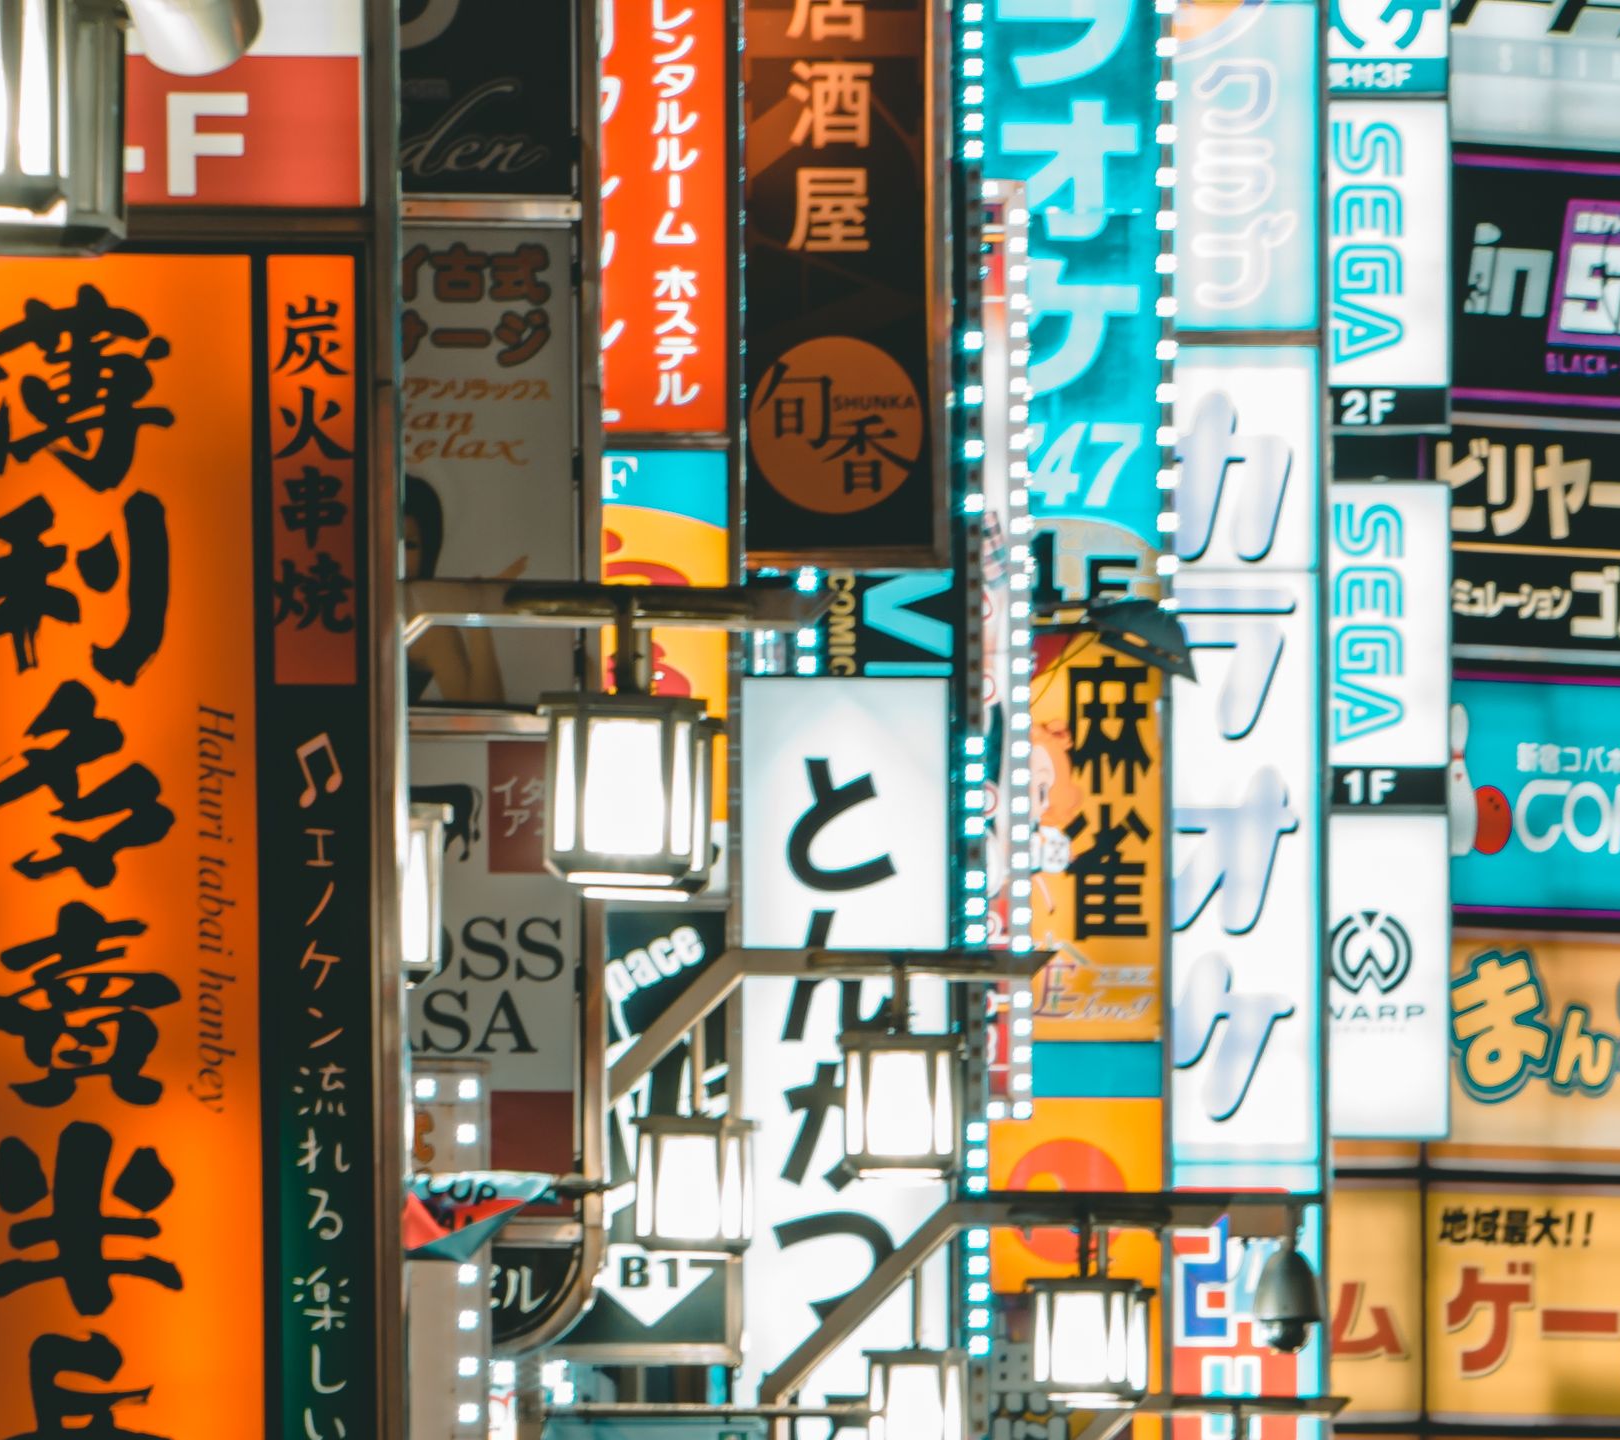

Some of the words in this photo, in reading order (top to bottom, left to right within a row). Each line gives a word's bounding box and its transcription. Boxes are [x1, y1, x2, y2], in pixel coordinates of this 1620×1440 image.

[1331, 120, 1404, 365] SEGA
[651, 265, 701, 408] ホステル
[831, 393, 918, 412] SHUNKA
[1340, 389, 1397, 425] 2F
[1331, 502, 1404, 746] SEGA
[196, 704, 238, 849] Hakuri
[1066, 655, 1152, 942] 麻雀
[1342, 768, 1398, 804] 1F
[196, 853, 238, 962] tabai
[1437, 1207, 1594, 1250] 地域最大!!
